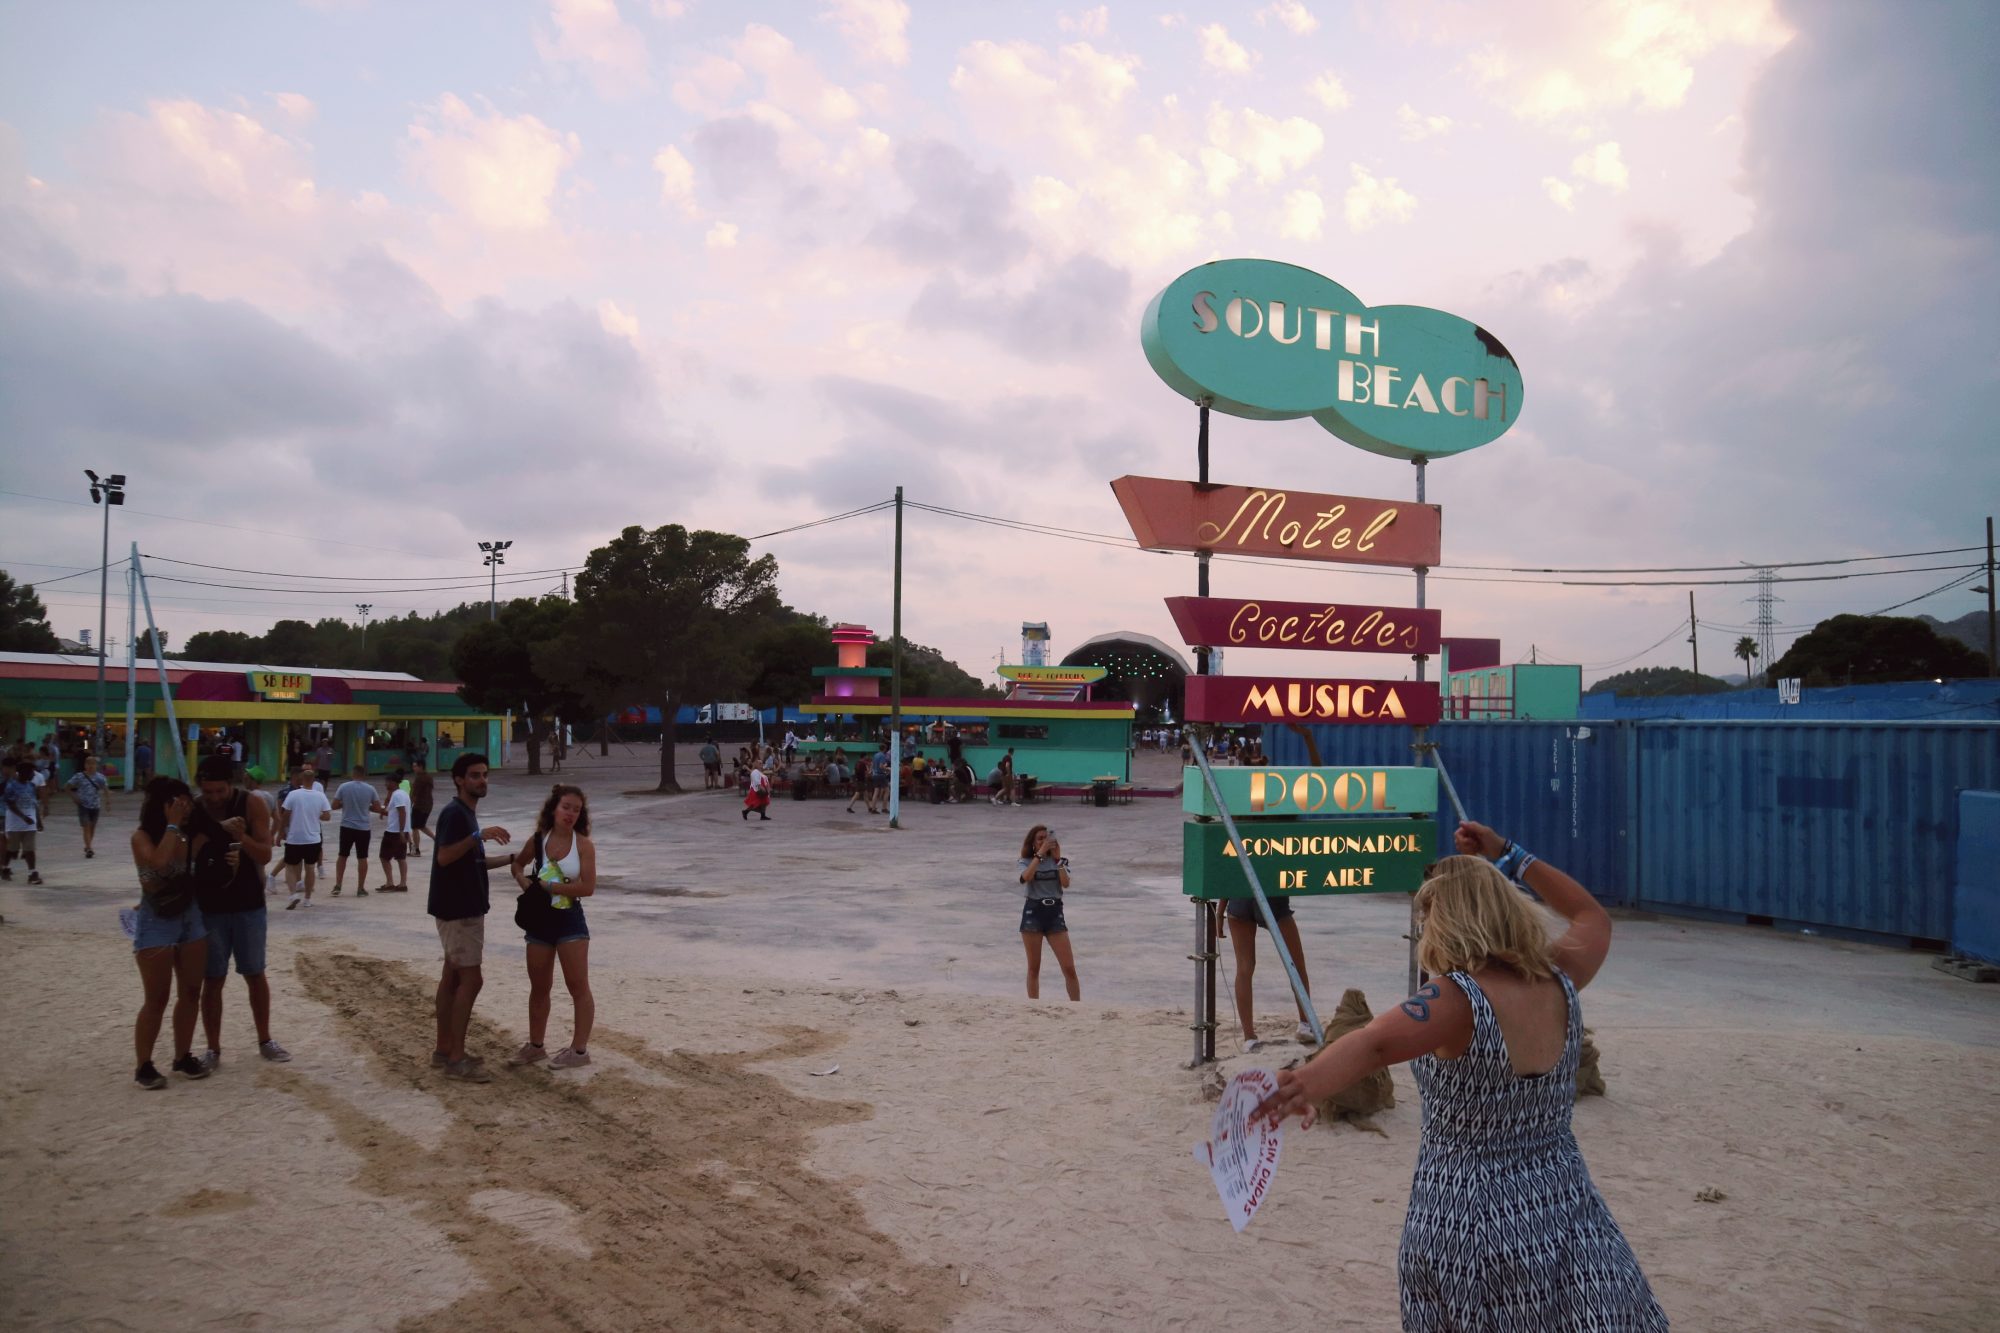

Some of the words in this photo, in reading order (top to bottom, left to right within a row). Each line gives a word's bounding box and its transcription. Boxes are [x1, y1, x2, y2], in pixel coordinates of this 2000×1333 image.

[1191, 290, 1379, 358] SOUTH
[1338, 360, 1507, 422] BEACH
[1198, 490, 1398, 552] Motel
[1229, 602, 1419, 649] Cocteles
[263, 674, 277, 687] SB
[281, 674, 304, 688] BAR
[1240, 683, 1407, 719] MUSICA
[1250, 771, 1396, 812] POOL
[1222, 834, 1422, 857] ACONDICIONADOR
[1279, 870, 1308, 889] DE
[1323, 867, 1375, 887] AIRE
[1266, 1138, 1278, 1164] SIN
[1243, 1168, 1271, 1217] DUDAS
